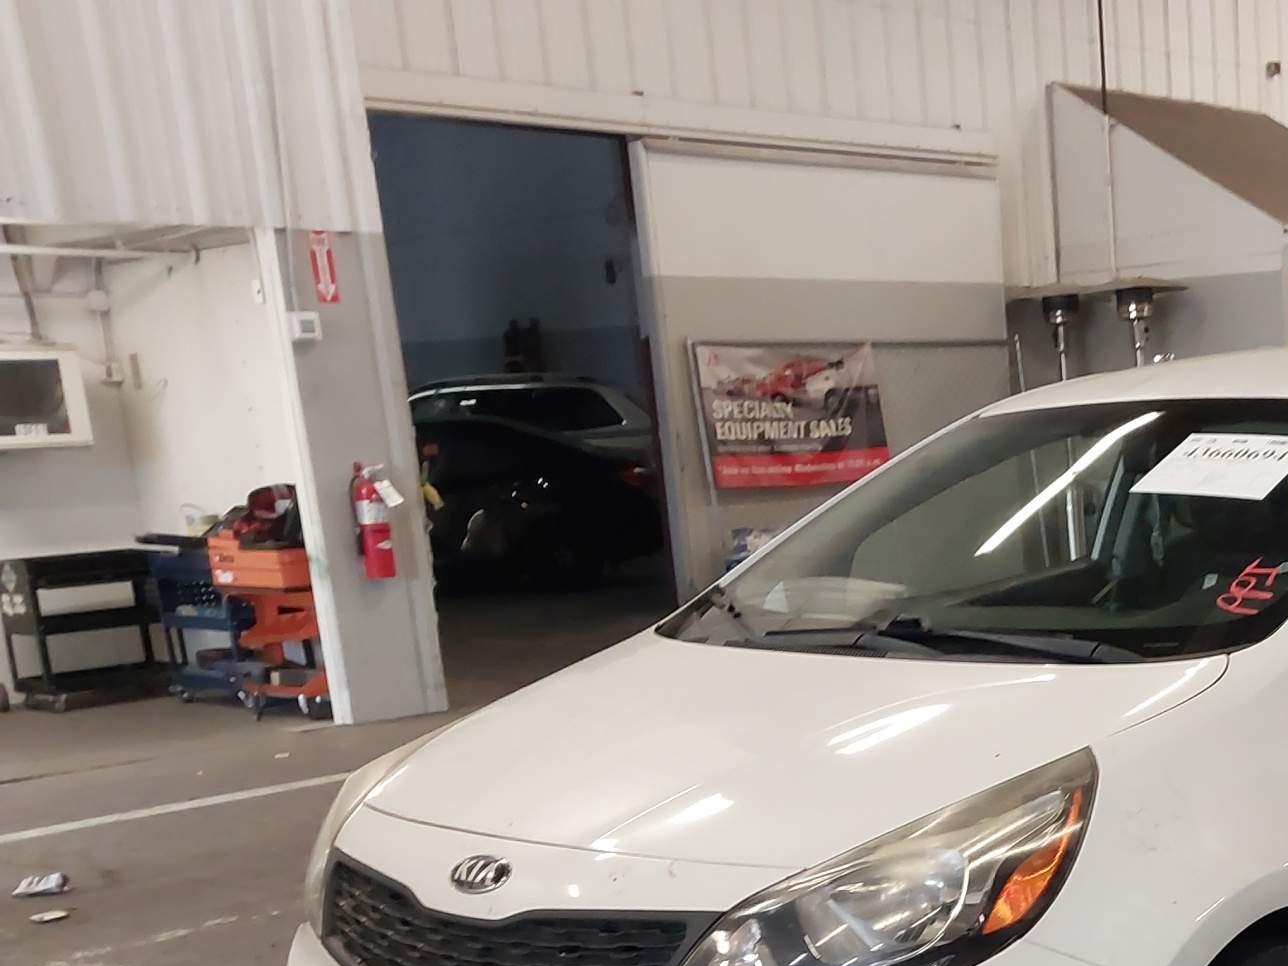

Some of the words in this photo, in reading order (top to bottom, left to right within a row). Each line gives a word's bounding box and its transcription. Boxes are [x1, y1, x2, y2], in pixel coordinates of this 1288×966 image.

[711, 399, 795, 419] SPECIALTY
[714, 419, 807, 441] EQUIPMENT
[809, 416, 853, 439] SALES
